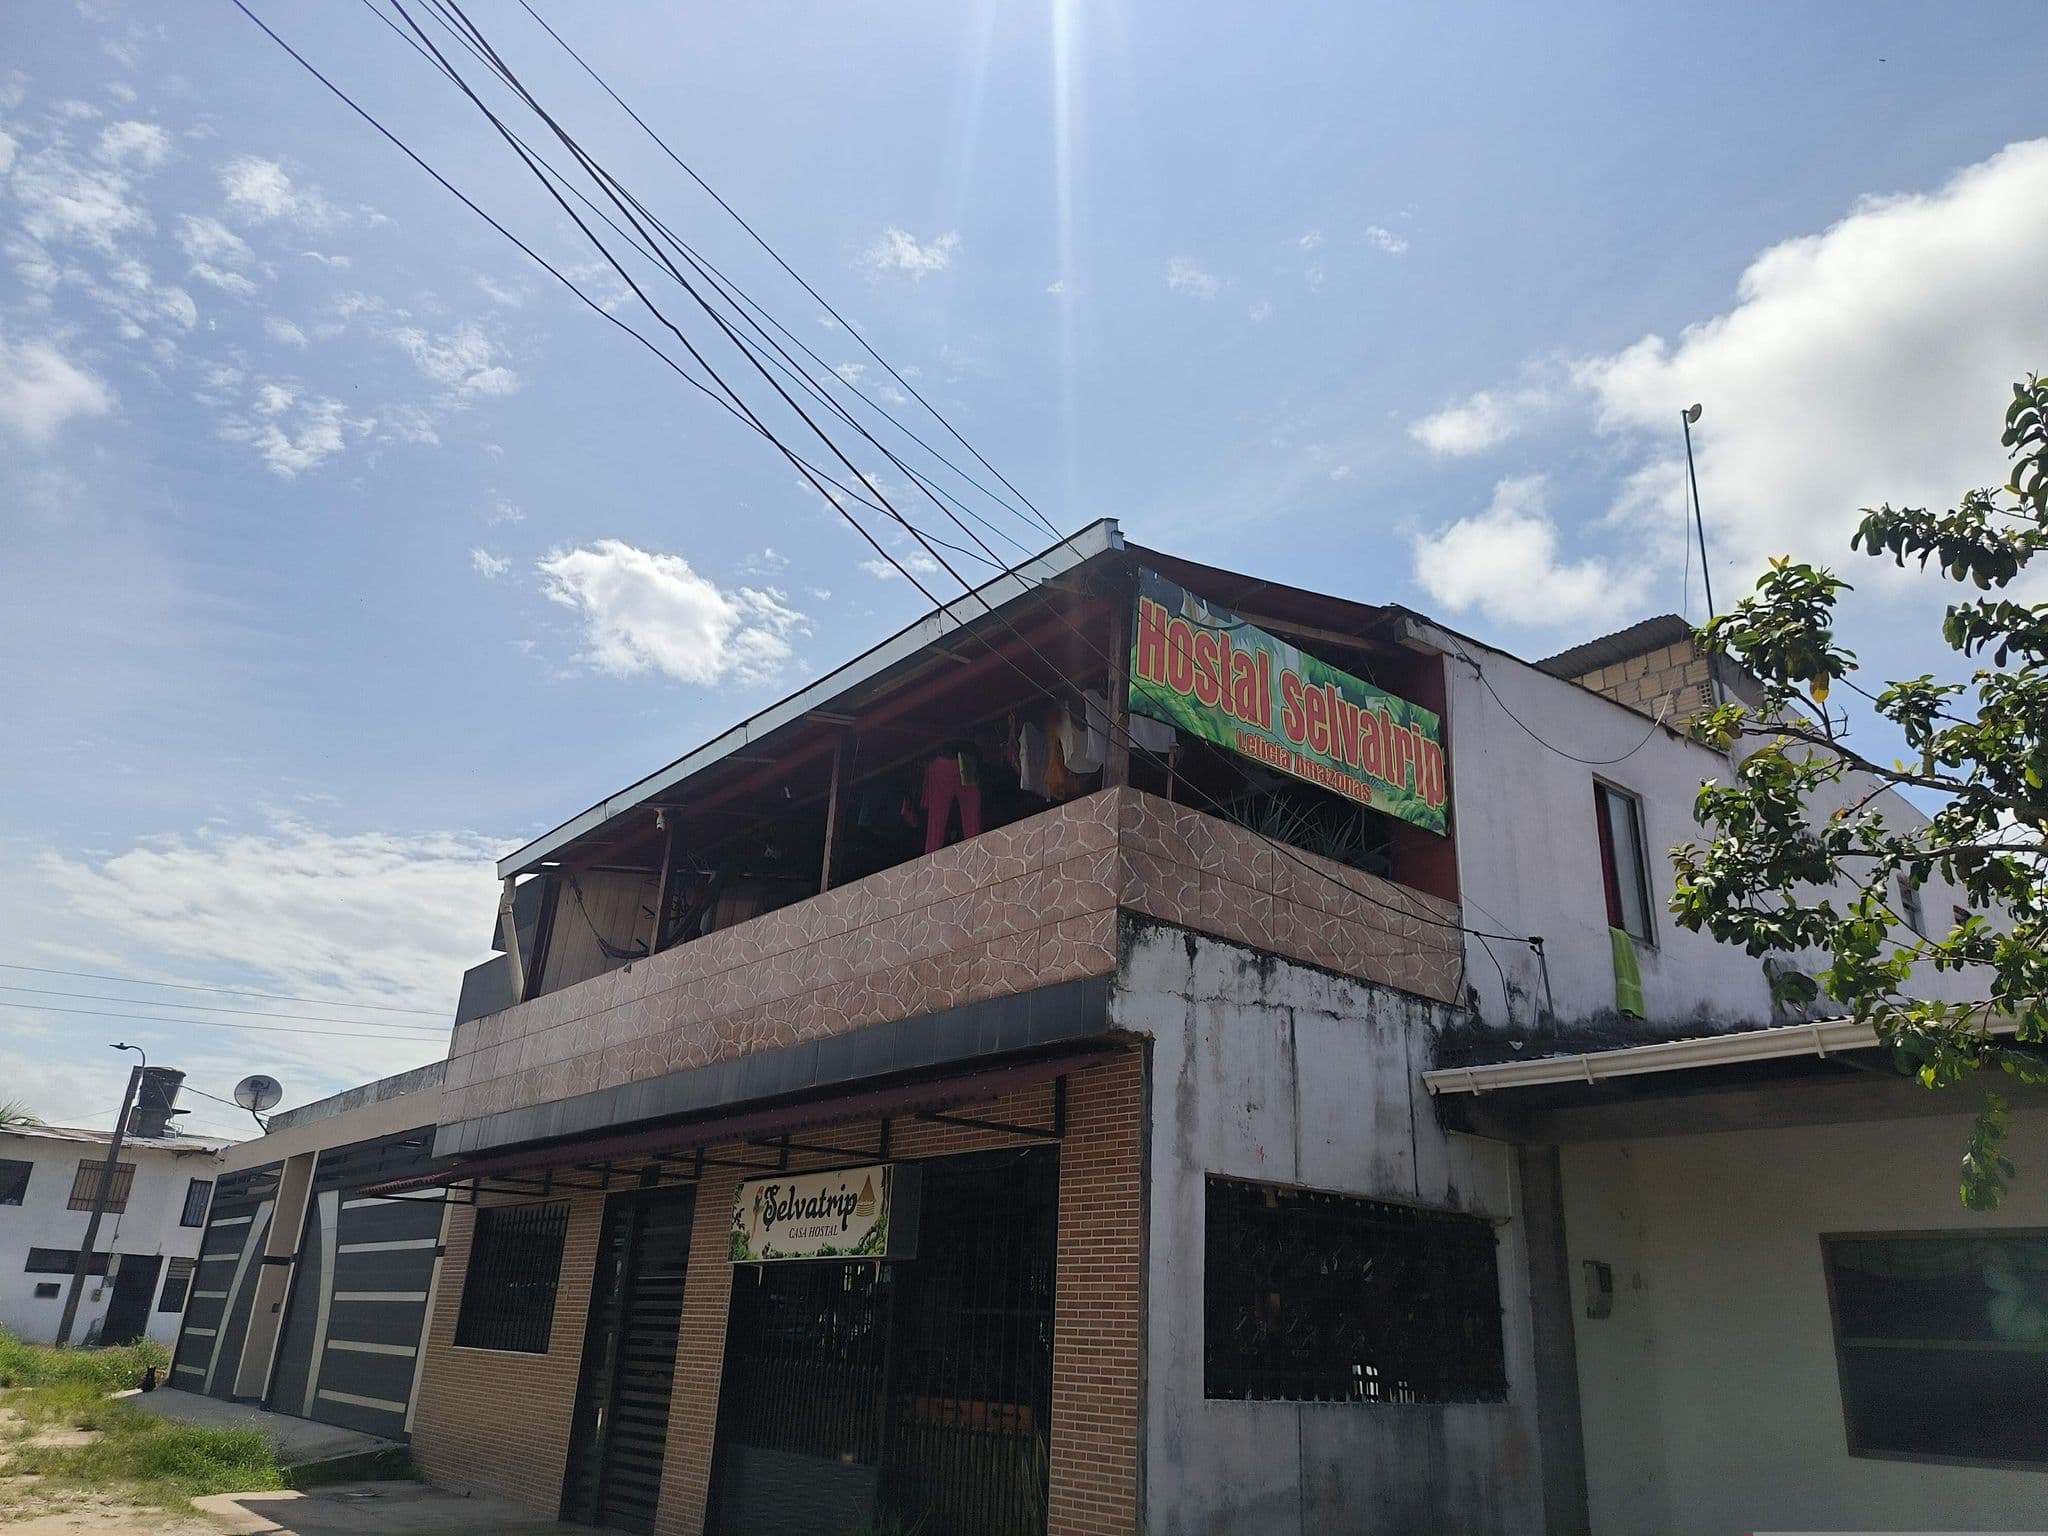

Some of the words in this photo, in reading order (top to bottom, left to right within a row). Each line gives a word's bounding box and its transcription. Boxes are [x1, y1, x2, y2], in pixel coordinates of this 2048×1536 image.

[1137, 596, 1272, 733] Hostal
[1236, 728, 1292, 769] Leticia
[1294, 752, 1372, 803] Amazonas
[763, 1184, 857, 1232] Selvatrip
[789, 1227, 807, 1239] CASA
[808, 1225, 839, 1238] HOSTAL
